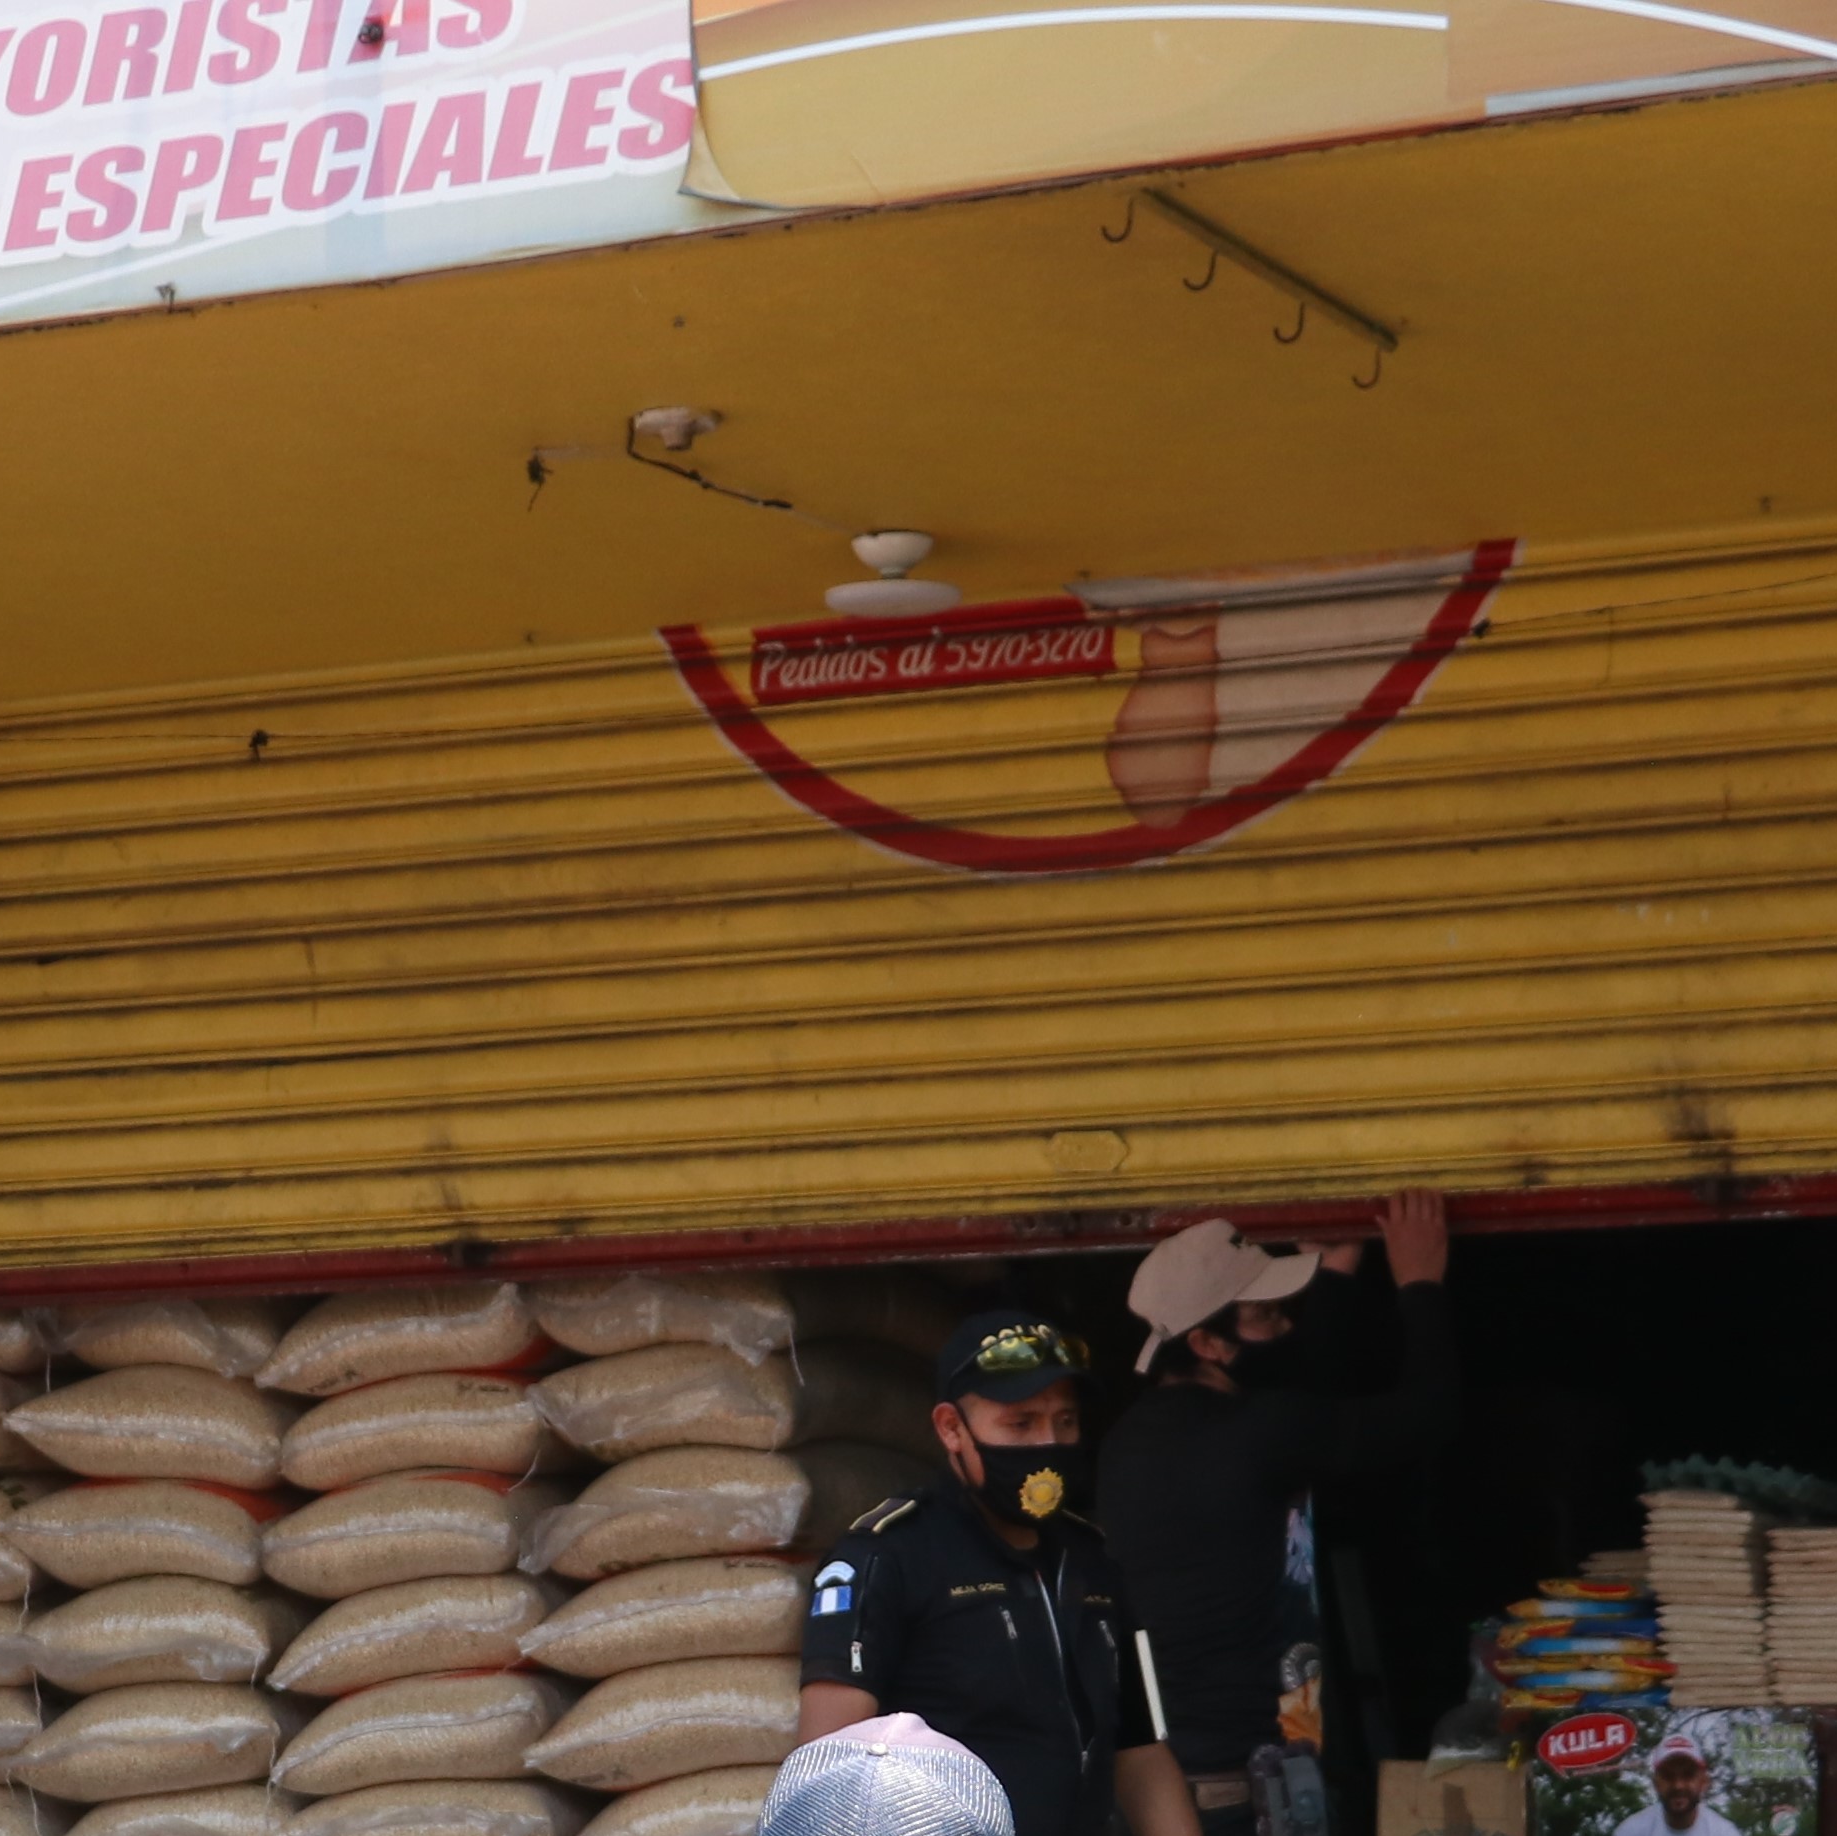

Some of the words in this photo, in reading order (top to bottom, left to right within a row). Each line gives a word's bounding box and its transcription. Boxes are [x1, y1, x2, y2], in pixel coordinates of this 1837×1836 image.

[2, 58, 695, 253] ESPECIALES
[757, 636, 888, 691] Pedidos
[1547, 1723, 1627, 1758] KULA
